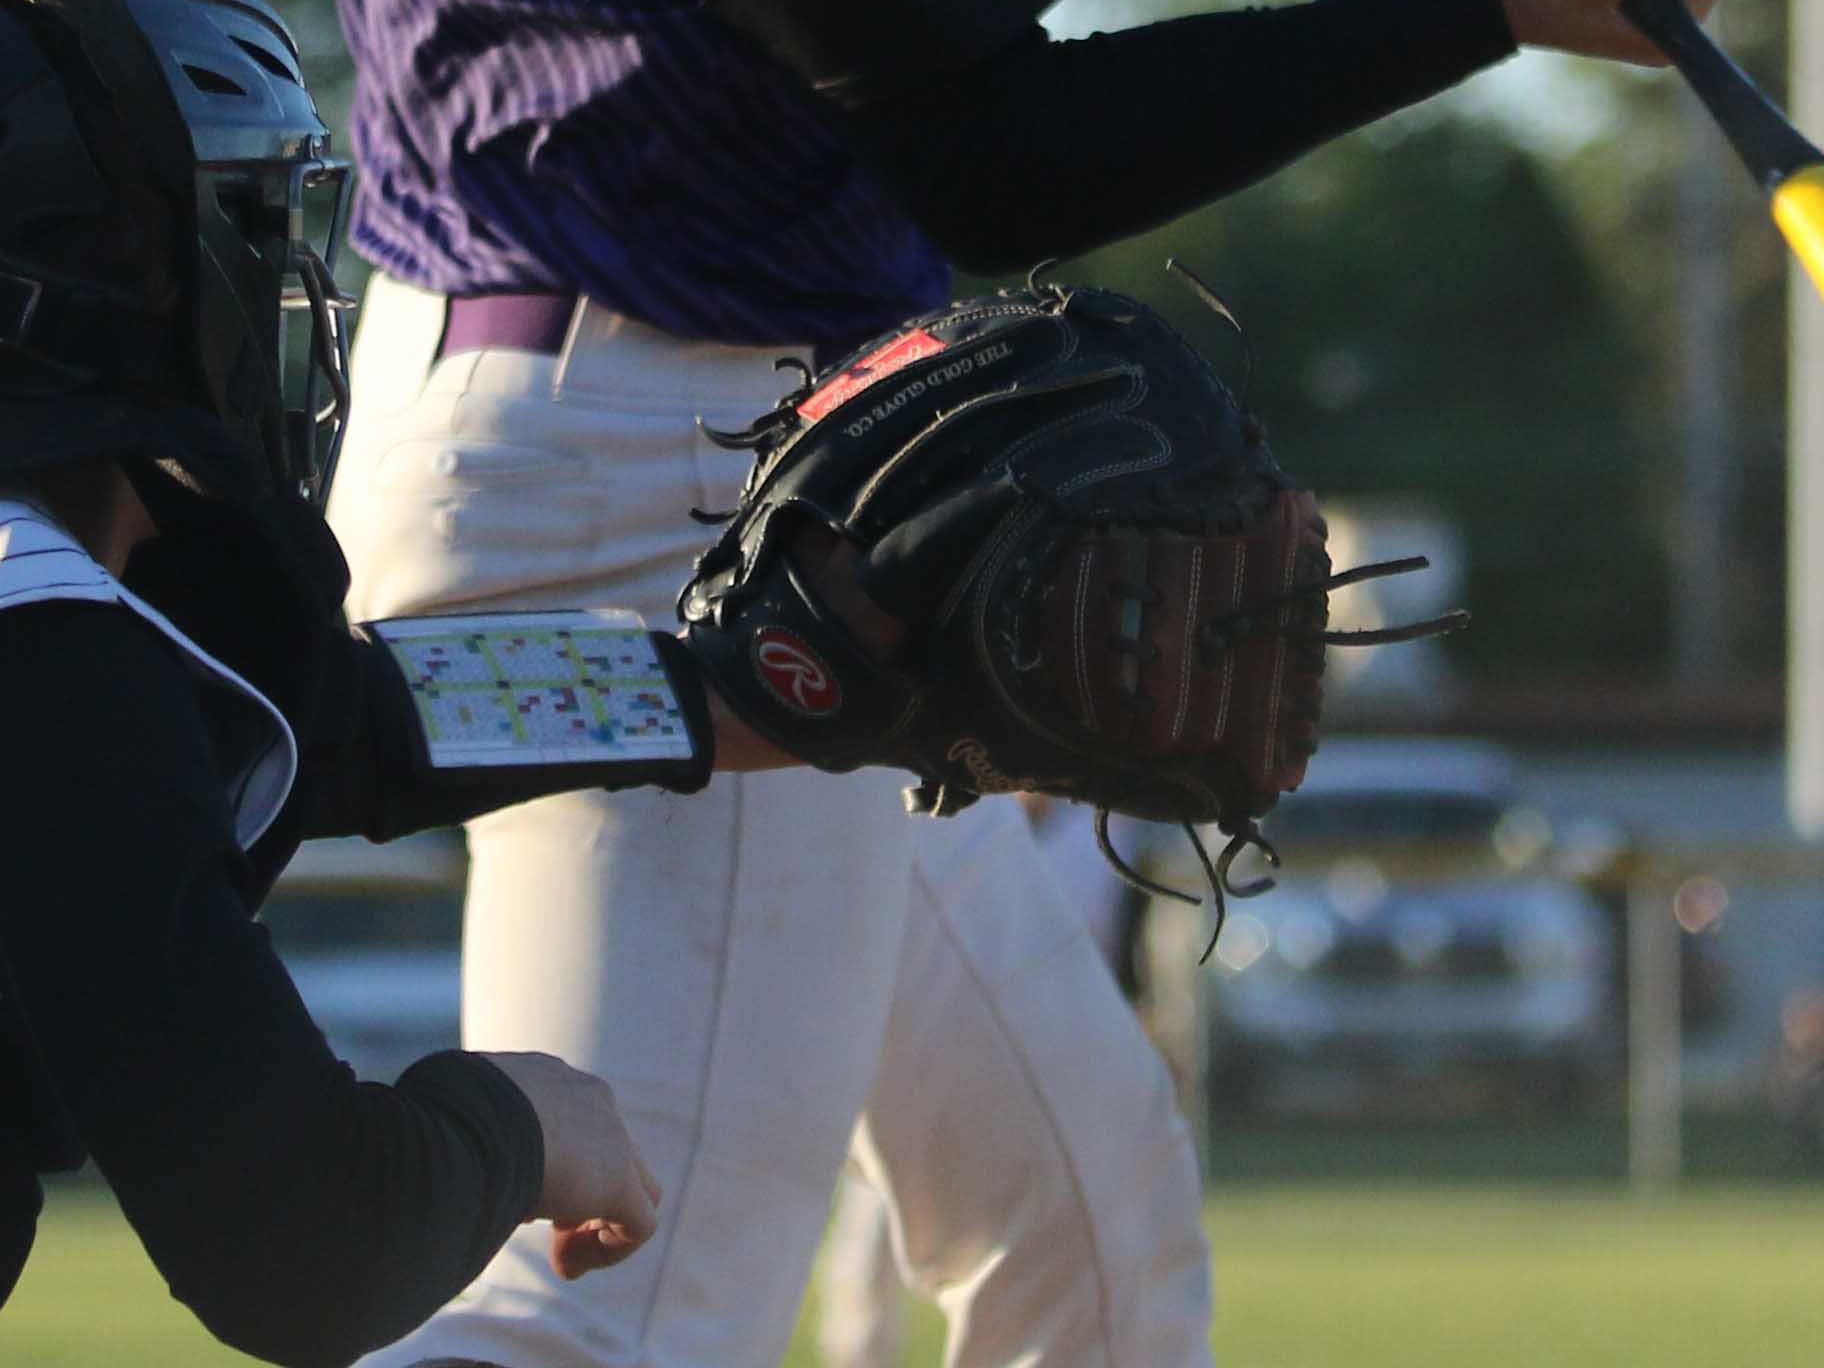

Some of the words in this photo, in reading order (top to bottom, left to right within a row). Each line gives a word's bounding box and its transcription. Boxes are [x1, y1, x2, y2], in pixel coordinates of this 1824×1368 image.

[975, 341, 1014, 368] THE
[929, 359, 973, 387] GOLD
[876, 380, 927, 417] GLOVE
